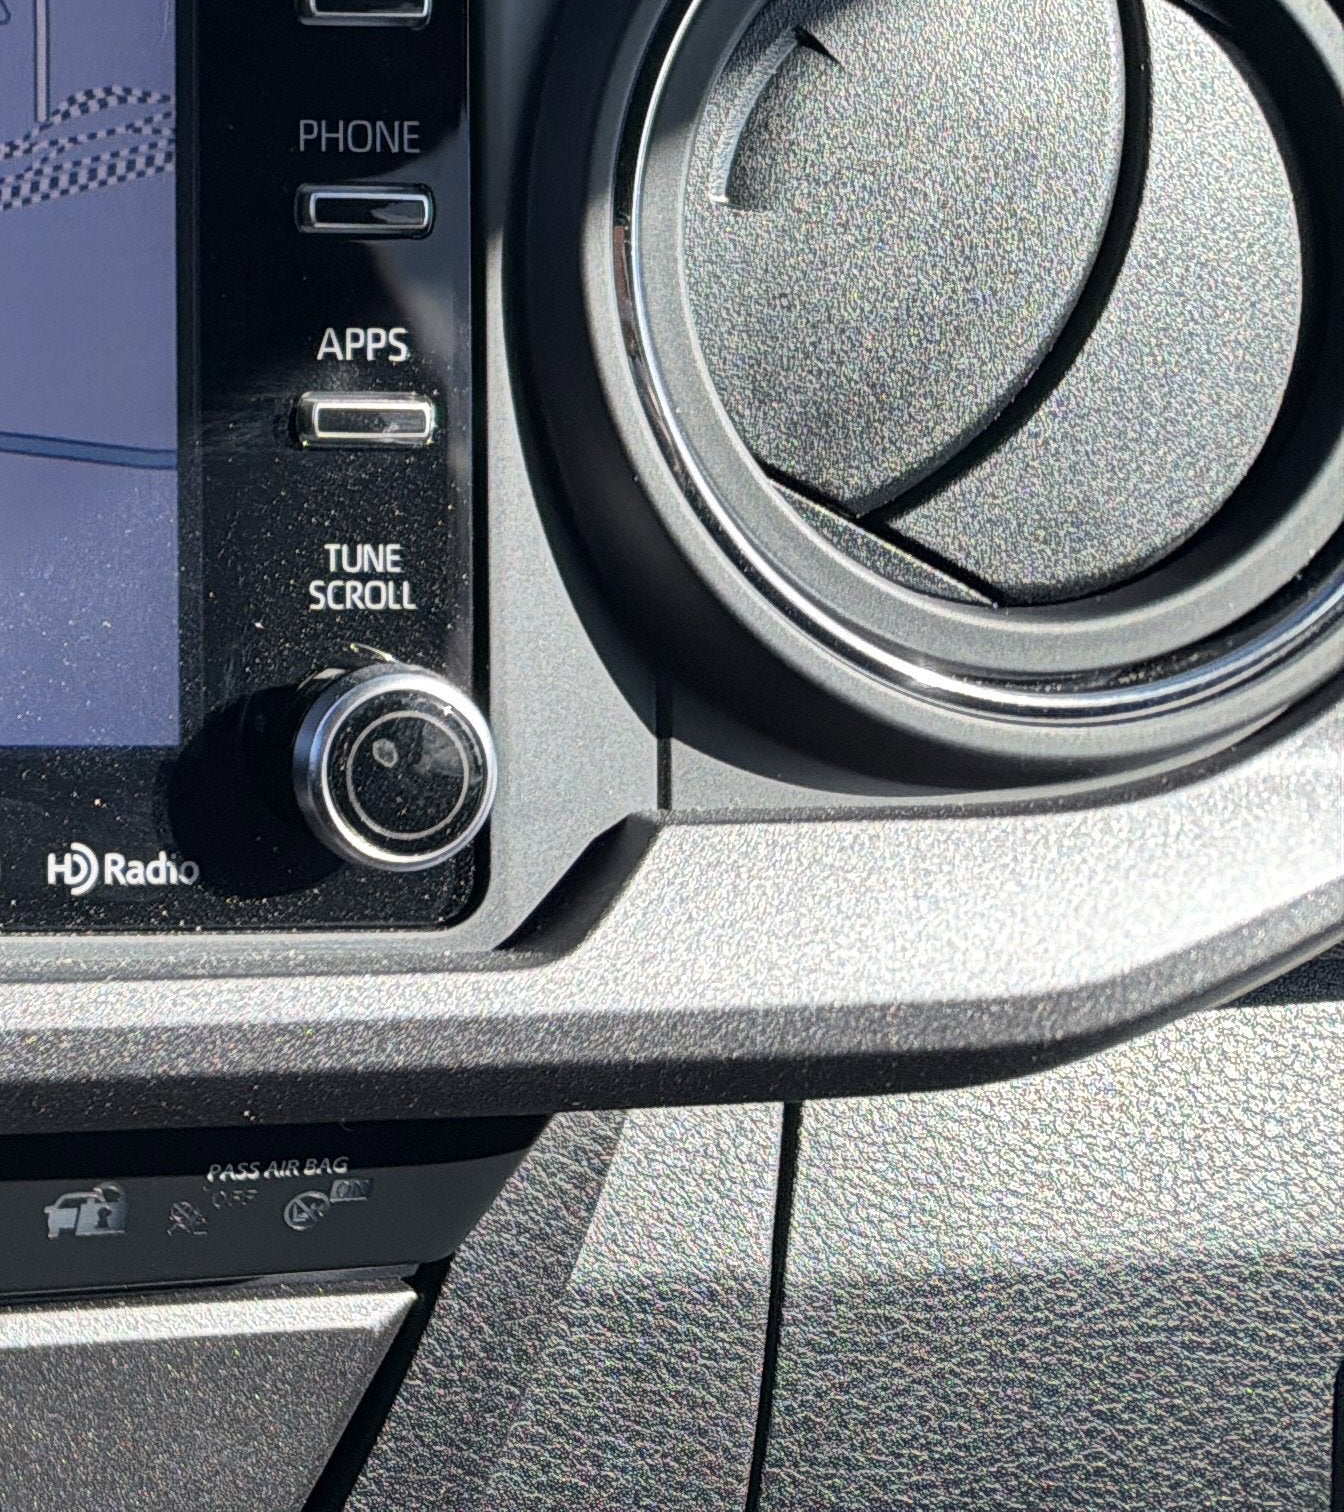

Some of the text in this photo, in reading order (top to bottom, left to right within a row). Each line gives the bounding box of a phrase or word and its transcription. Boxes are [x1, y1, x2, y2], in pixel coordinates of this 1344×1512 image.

[299, 120, 421, 154] PHONE
[317, 327, 408, 362] APPS
[324, 543, 402, 573] TUNE
[309, 580, 417, 610] SCROLL
[104, 850, 200, 887] Radio
[207, 1155, 349, 1182] PASS AIR BAG
